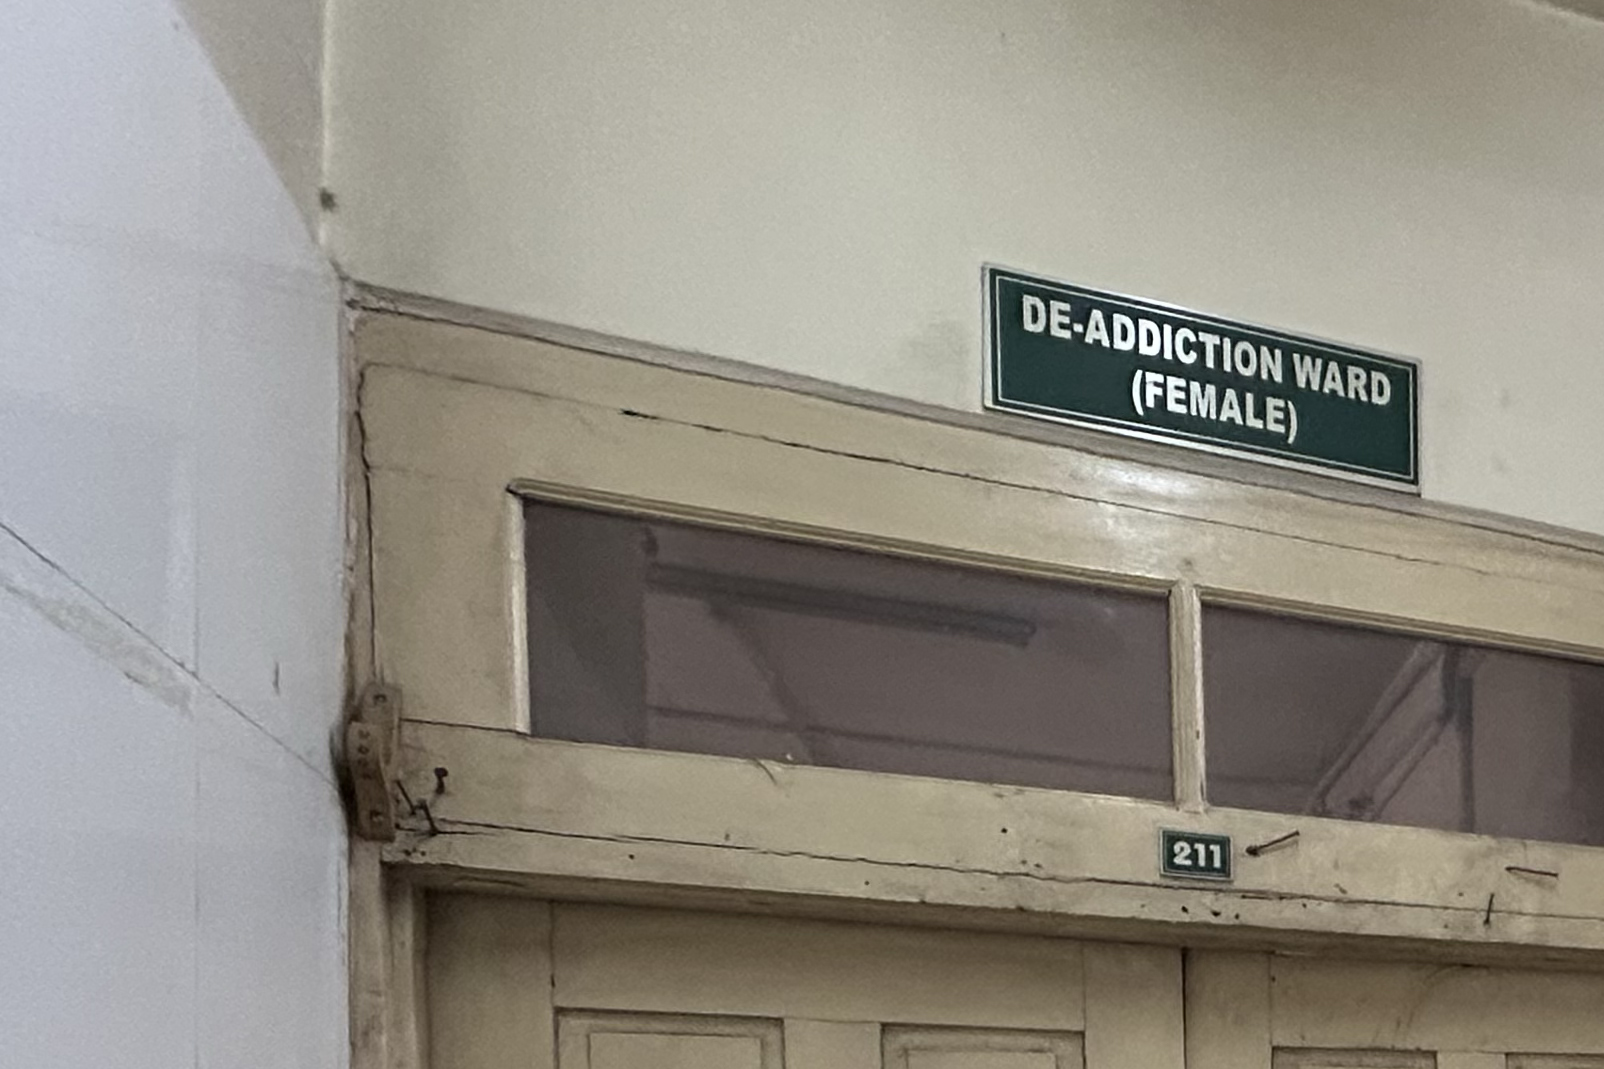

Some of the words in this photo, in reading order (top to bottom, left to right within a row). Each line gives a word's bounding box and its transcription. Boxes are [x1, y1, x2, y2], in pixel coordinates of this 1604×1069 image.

[1022, 294, 1283, 383] DE-ADDICTION
[1293, 353, 1391, 406] WARD
[1132, 369, 1298, 443] (FEMALE)
[1173, 840, 1222, 868] 211
